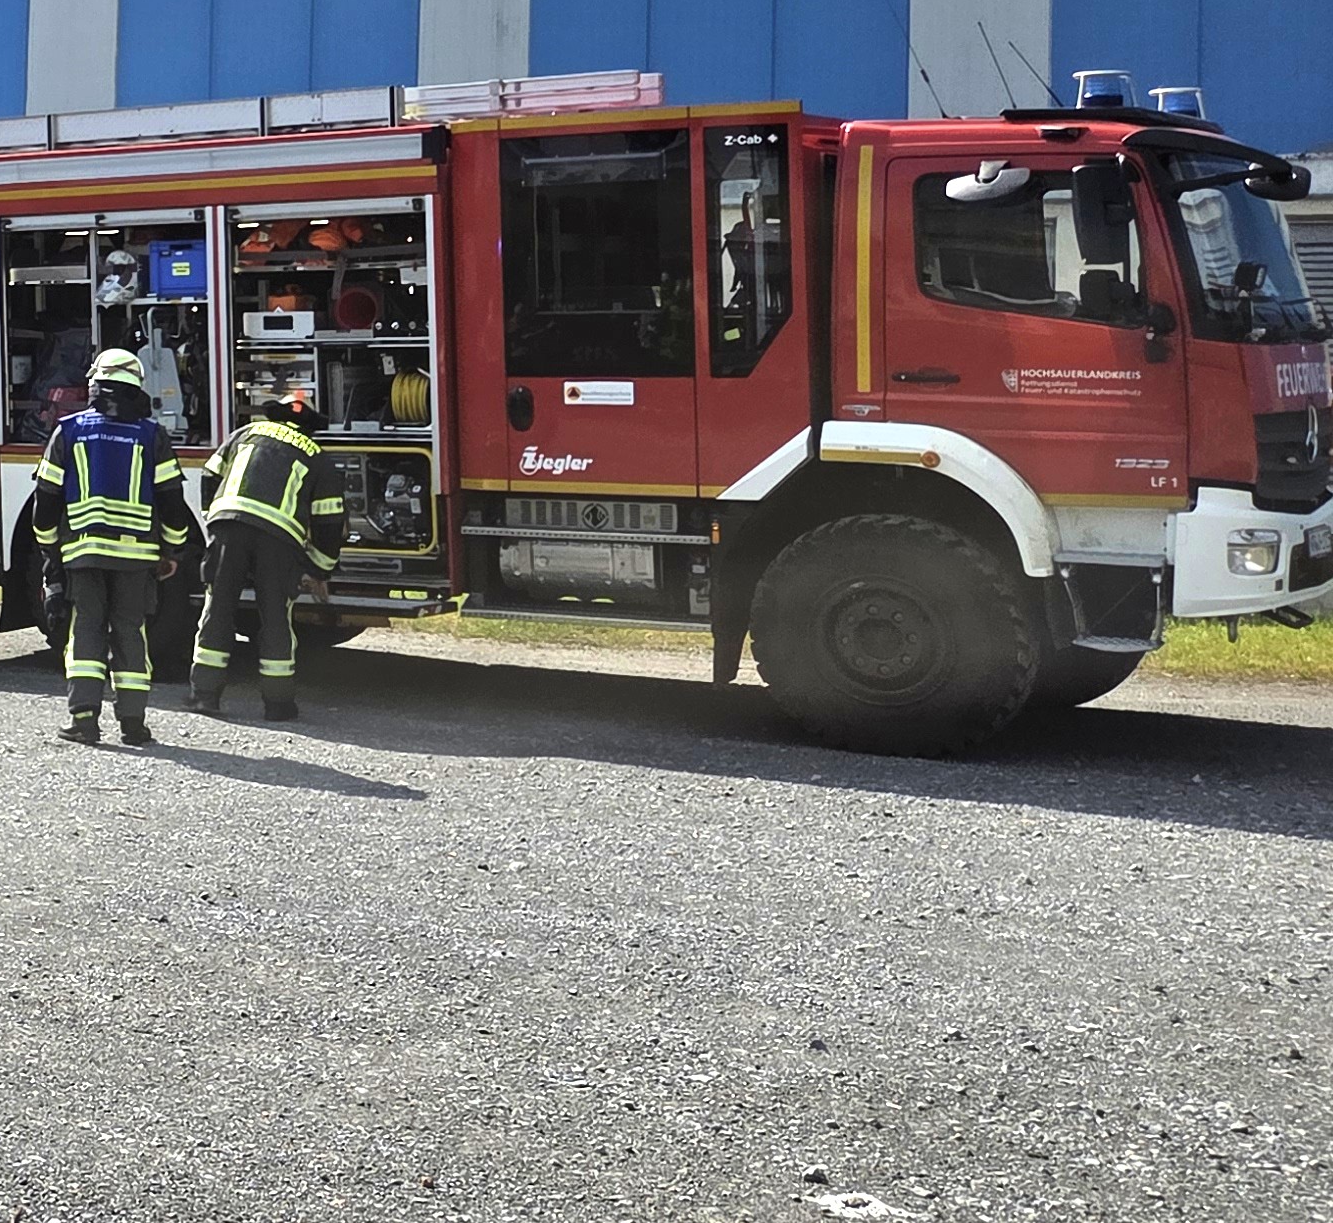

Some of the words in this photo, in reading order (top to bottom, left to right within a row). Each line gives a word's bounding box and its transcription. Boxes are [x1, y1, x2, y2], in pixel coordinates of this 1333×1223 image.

[724, 134, 763, 146] Z-Cab
[1020, 369, 1142, 379] HOCHSAUERLANDKREIS
[519, 446, 593, 476] Ziegler
[1150, 476, 1167, 488] LF
[1171, 477, 1178, 488] 1
